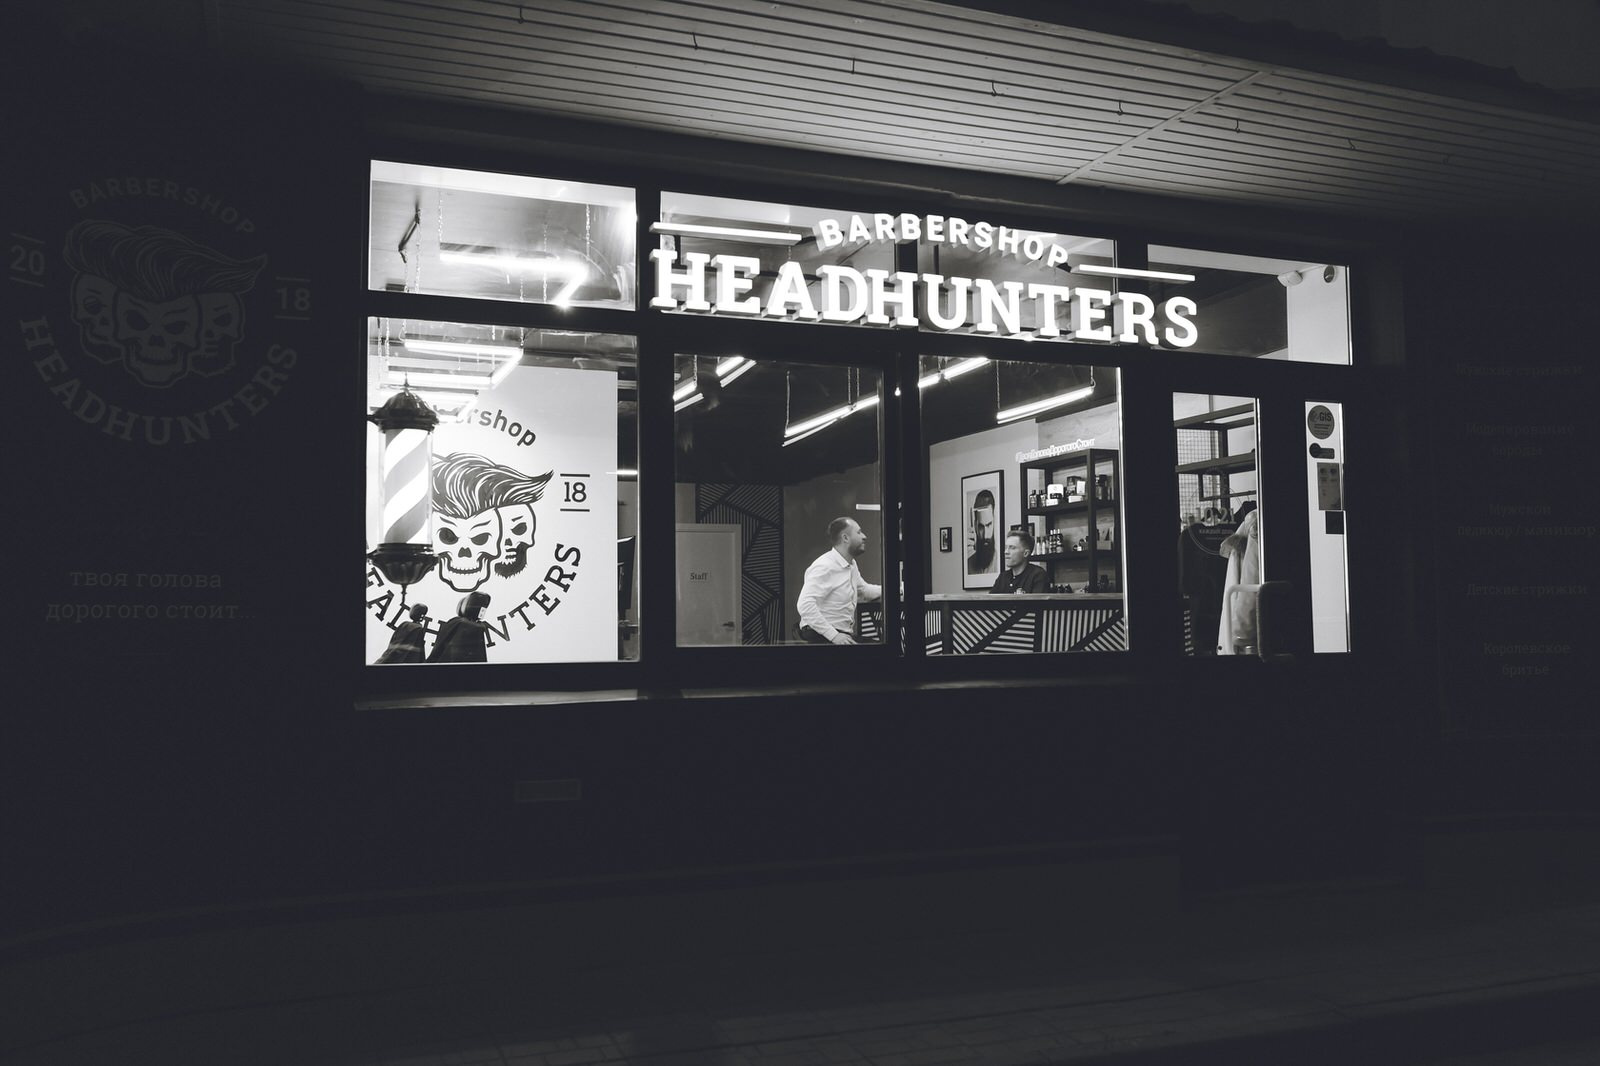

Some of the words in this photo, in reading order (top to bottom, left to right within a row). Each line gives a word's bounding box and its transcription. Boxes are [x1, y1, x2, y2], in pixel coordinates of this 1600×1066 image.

[69, 176, 256, 236] BARBERSHOP
[816, 213, 1069, 269] BARBERSHOP
[9, 245, 46, 276] 20
[276, 286, 311, 312] 18
[650, 248, 1199, 348] HEADHUNTERS
[19, 315, 298, 446] HEADHUNTERS
[564, 481, 587, 502] 18
[69, 571, 128, 587] твоя
[136, 572, 222, 588] голова
[45, 603, 159, 623] дорогого
